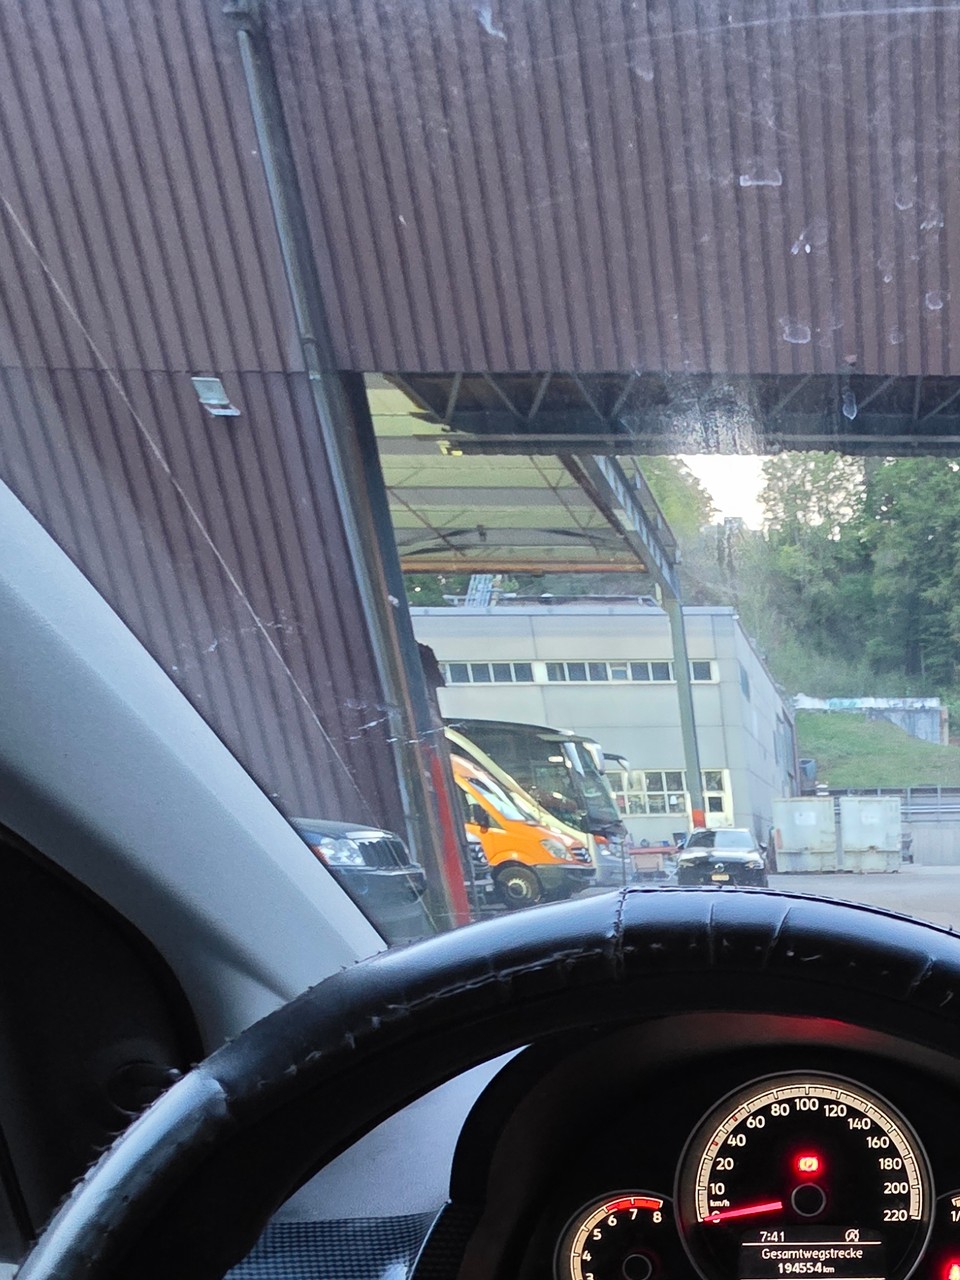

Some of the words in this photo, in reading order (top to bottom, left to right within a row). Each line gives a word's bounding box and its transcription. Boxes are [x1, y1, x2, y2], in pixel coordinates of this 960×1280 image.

[771, 1103, 790, 1117] 80
[795, 1098, 819, 1111] 100
[824, 1104, 847, 1118] 120
[746, 1115, 766, 1129] 60
[848, 1117, 871, 1130] 140
[727, 1133, 747, 1147] 40
[866, 1136, 890, 1149] 160
[716, 1157, 734, 1171] 20
[879, 1157, 902, 1170] 180
[710, 1182, 725, 1196] 10
[883, 1182, 909, 1194] 200
[710, 1199, 730, 1207] km/h
[607, 1214, 617, 1227] 6
[629, 1208, 638, 1220] 7
[652, 1211, 662, 1223] 8
[883, 1209, 908, 1222] 220
[593, 1228, 602, 1241] 5
[760, 1231, 785, 1242] 7:41
[582, 1250, 592, 1262] 4
[761, 1248, 863, 1261] Gesamtwegstrecke
